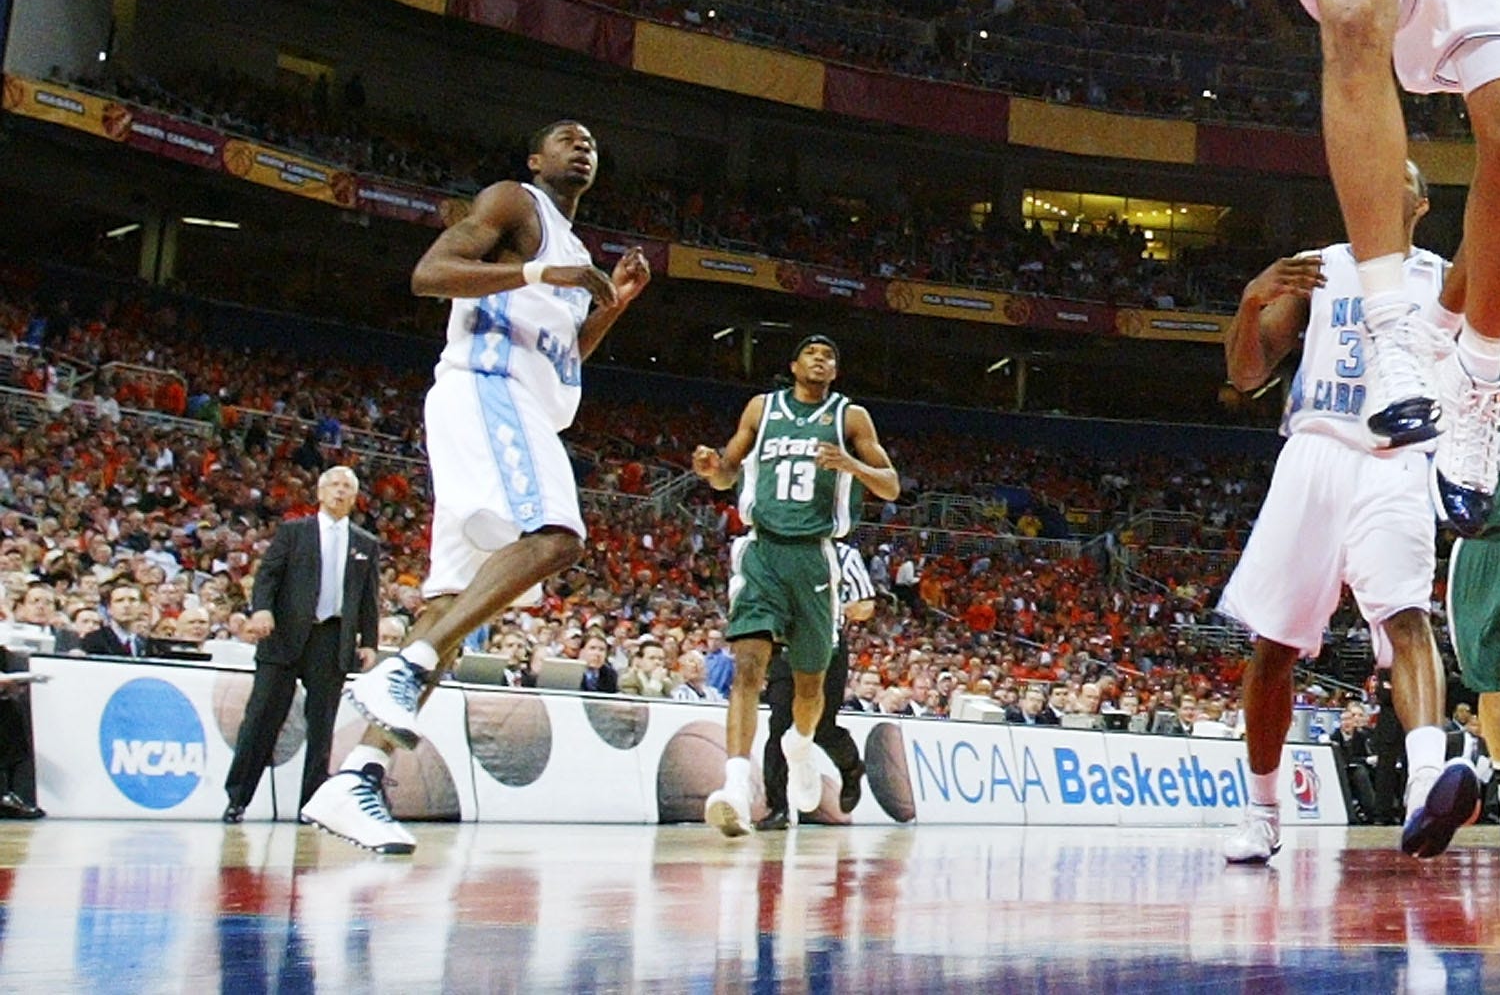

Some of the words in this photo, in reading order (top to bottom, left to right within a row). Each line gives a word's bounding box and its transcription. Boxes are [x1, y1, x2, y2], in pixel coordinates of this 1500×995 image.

[1335, 330, 1365, 378] 3
[1314, 379, 1366, 415] CARO
[760, 436, 819, 461] Stat
[775, 459, 816, 502] 13
[111, 738, 204, 776] NCAA
[913, 740, 1050, 804] NCAA
[1053, 747, 1249, 808] Basketbal
